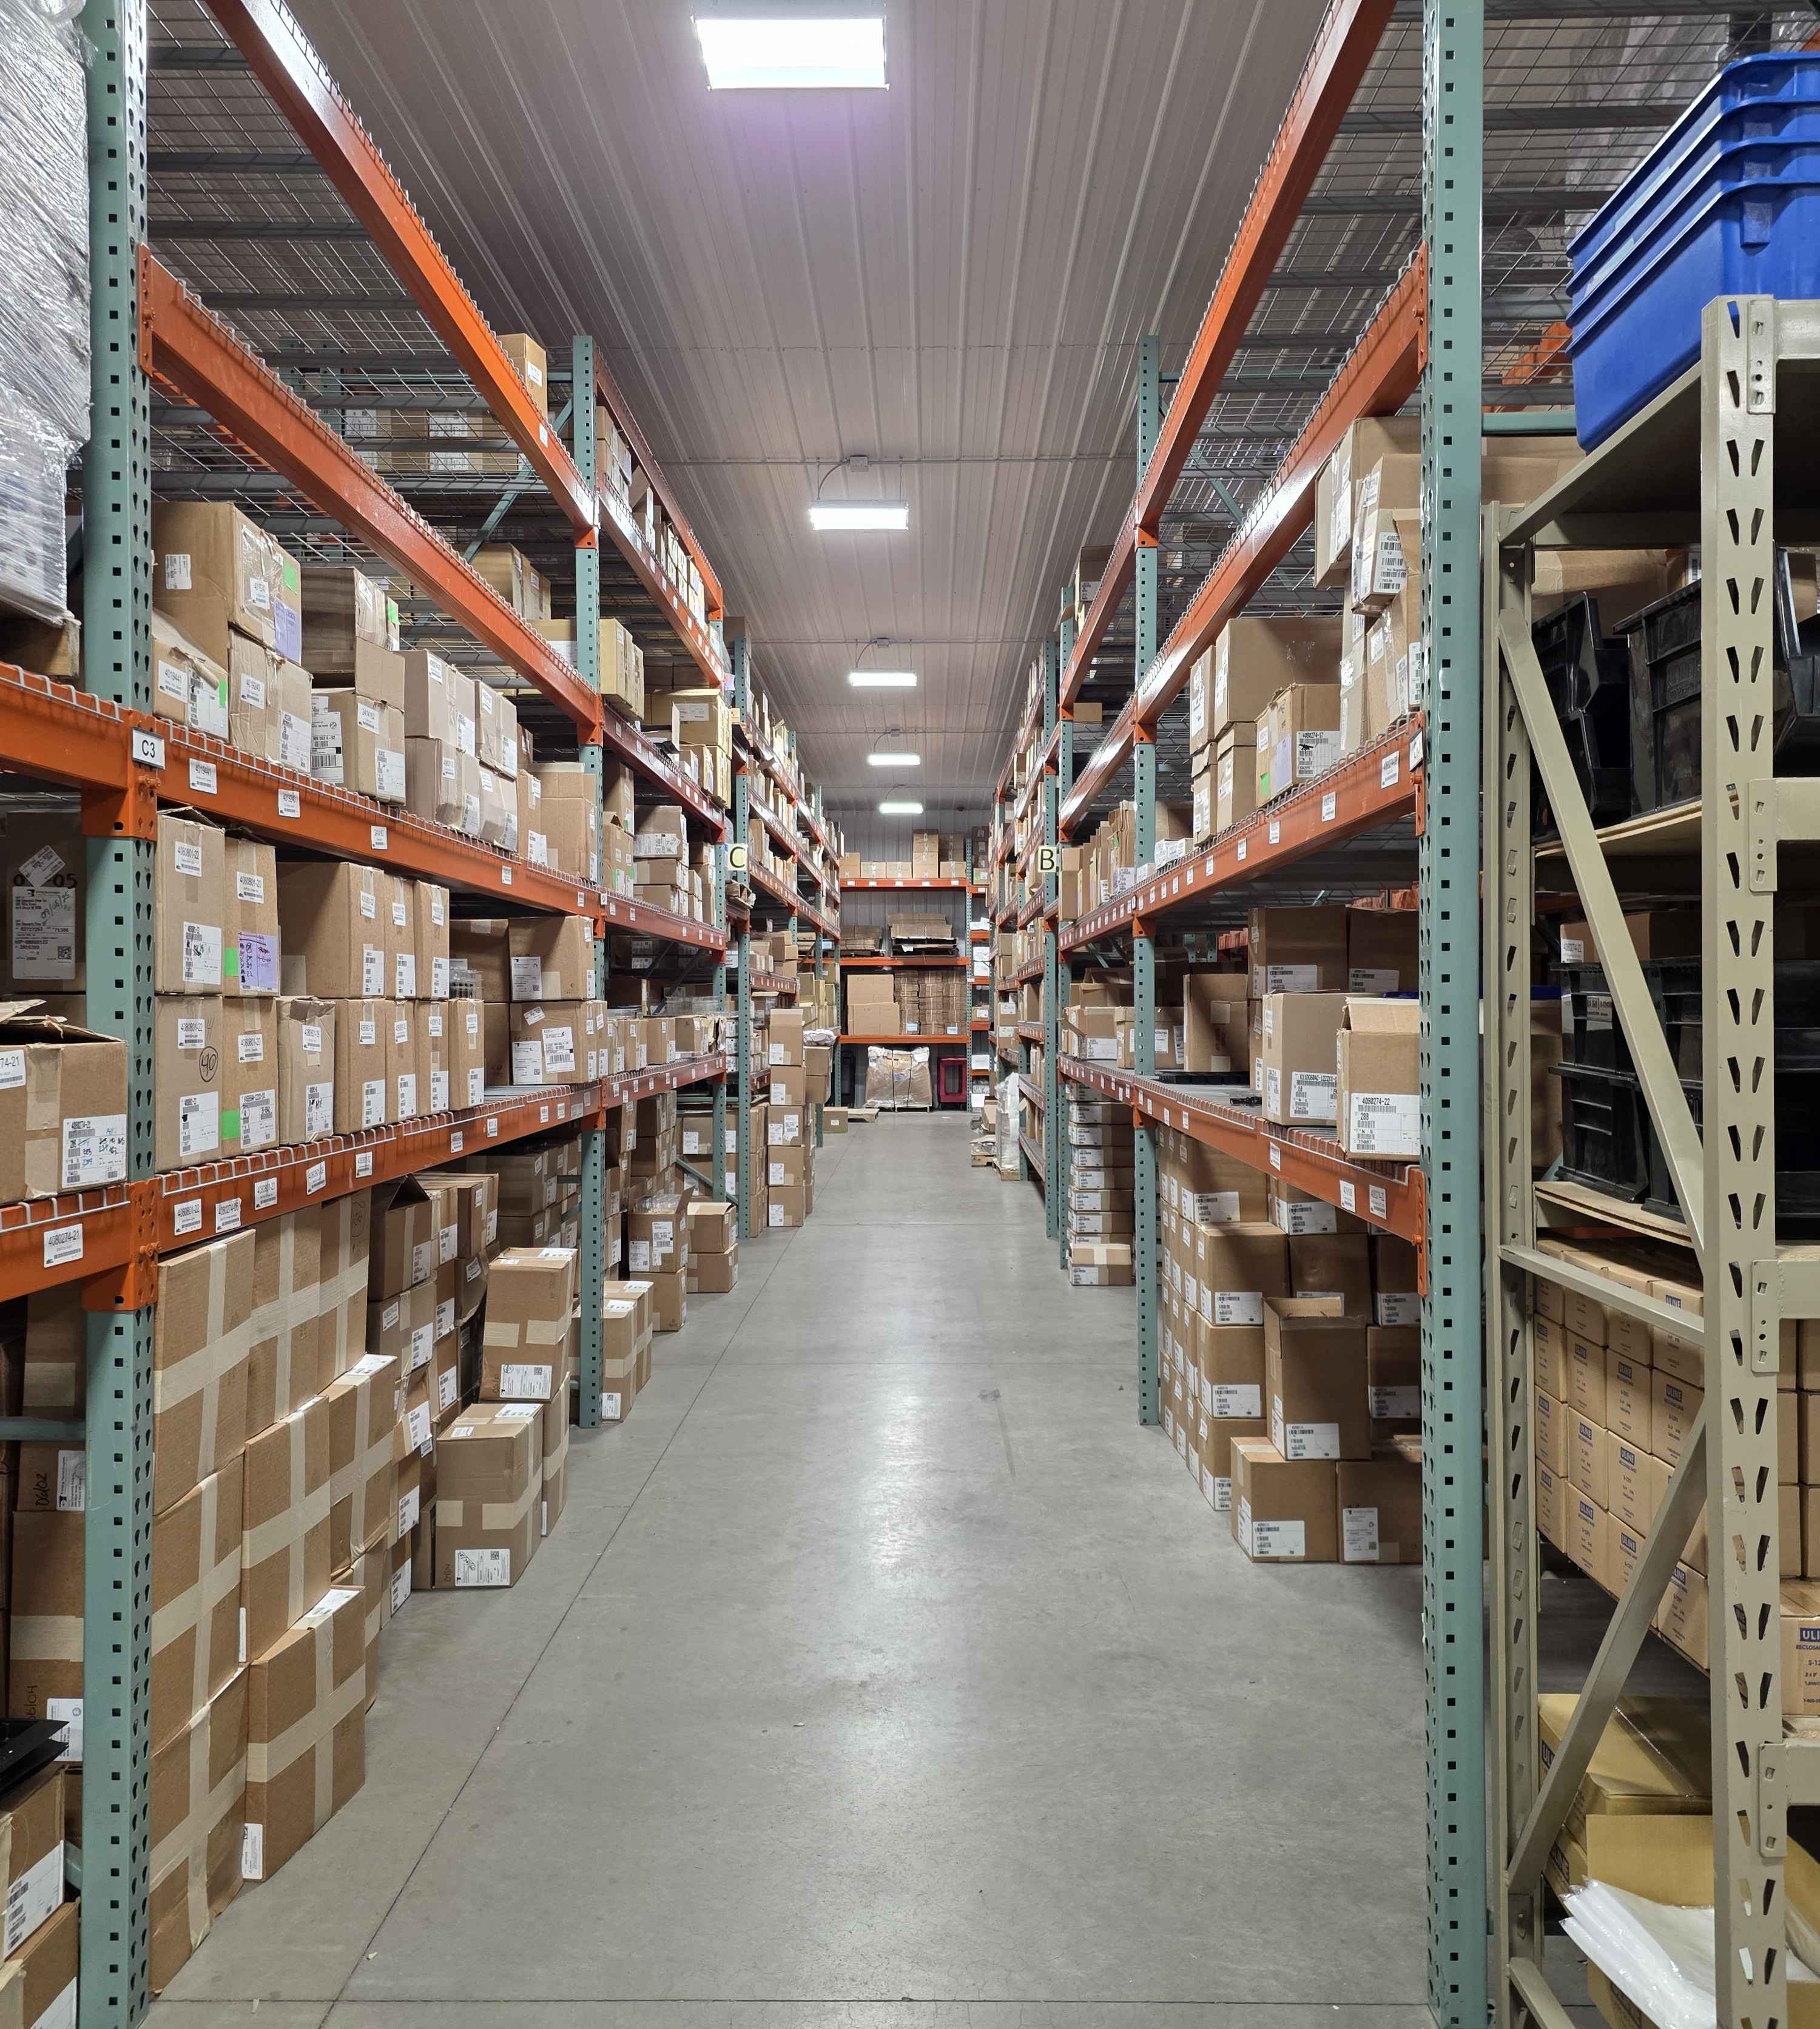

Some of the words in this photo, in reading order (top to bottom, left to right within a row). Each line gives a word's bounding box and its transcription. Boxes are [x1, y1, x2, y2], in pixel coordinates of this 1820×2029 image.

[142, 740, 155, 758] C3
[730, 846, 745, 868] C
[1040, 849, 1054, 870] B
[49, 1229, 80, 1246] 4080274-21
[1667, 1385, 1682, 1401] ULINE
[1621, 1448, 1634, 1464] ULINE
[1580, 1502, 1593, 1519] ULINE
[1622, 1534, 1636, 1551] ULINE
